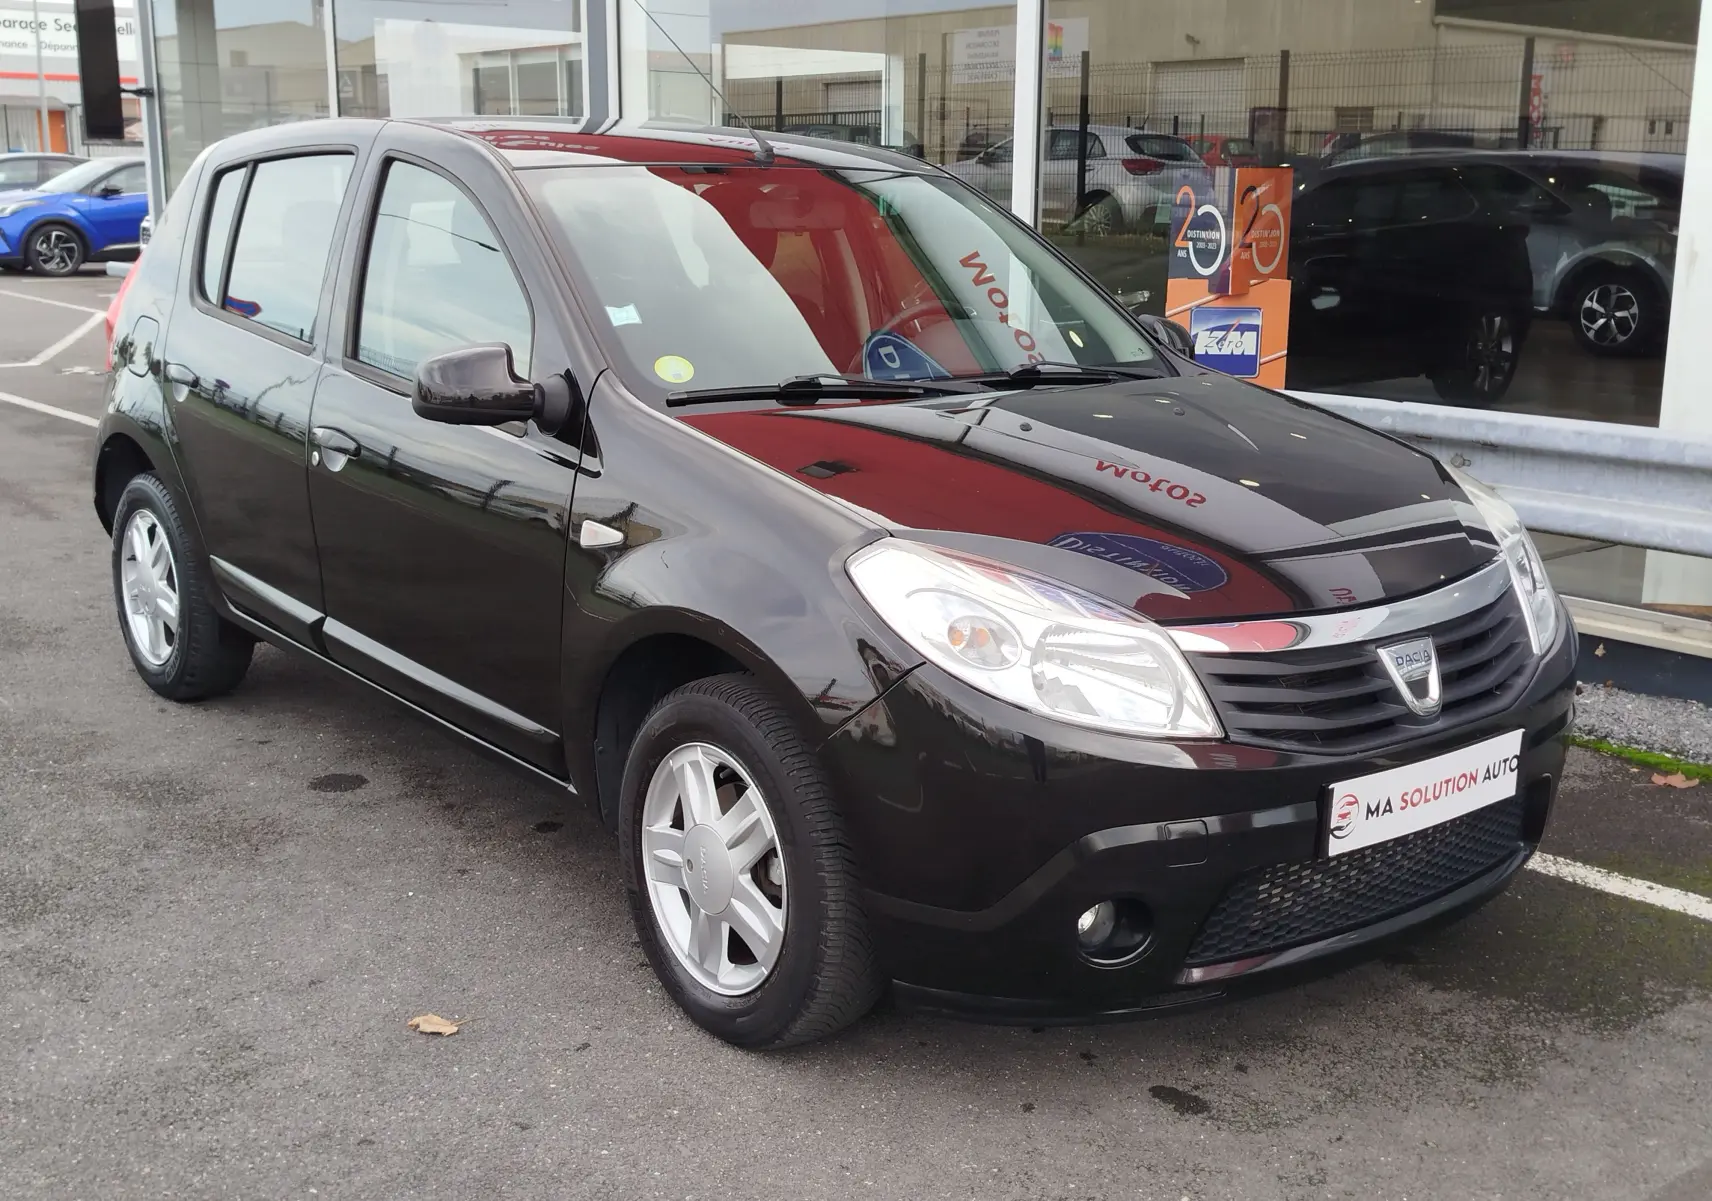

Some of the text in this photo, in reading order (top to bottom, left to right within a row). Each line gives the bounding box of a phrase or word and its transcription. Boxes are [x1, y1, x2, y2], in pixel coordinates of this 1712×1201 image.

[0, 19, 47, 33] arage
[1177, 249, 1187, 258] ANS
[1395, 649, 1432, 666] DACIA
[1365, 754, 1521, 821] MA SOLUTION AUTO
